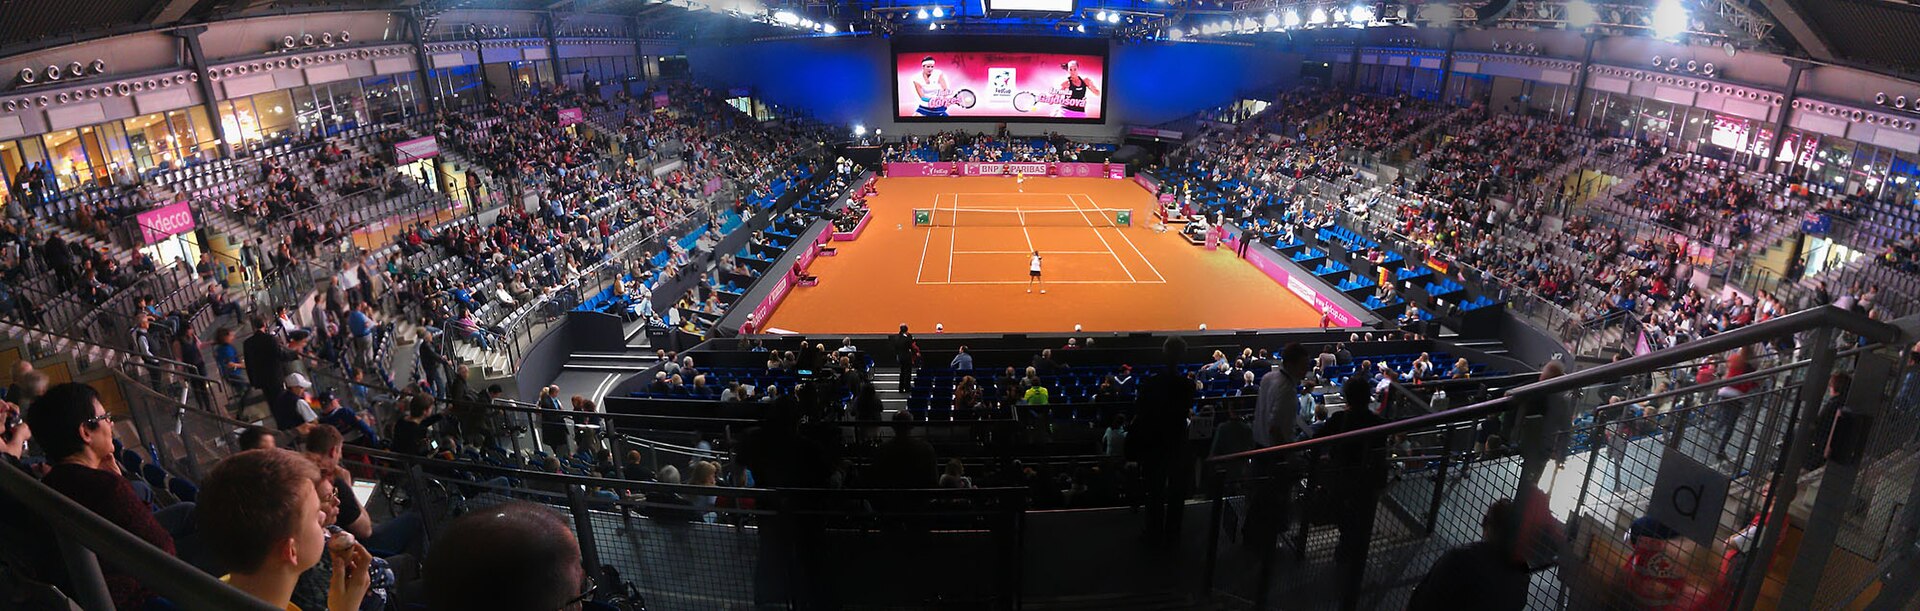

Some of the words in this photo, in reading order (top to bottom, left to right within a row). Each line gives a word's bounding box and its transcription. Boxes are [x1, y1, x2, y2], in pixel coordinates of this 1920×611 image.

[981, 165, 999, 173] BNP
[1011, 165, 1045, 173] PARIBAS
[146, 211, 190, 237] Adecco
